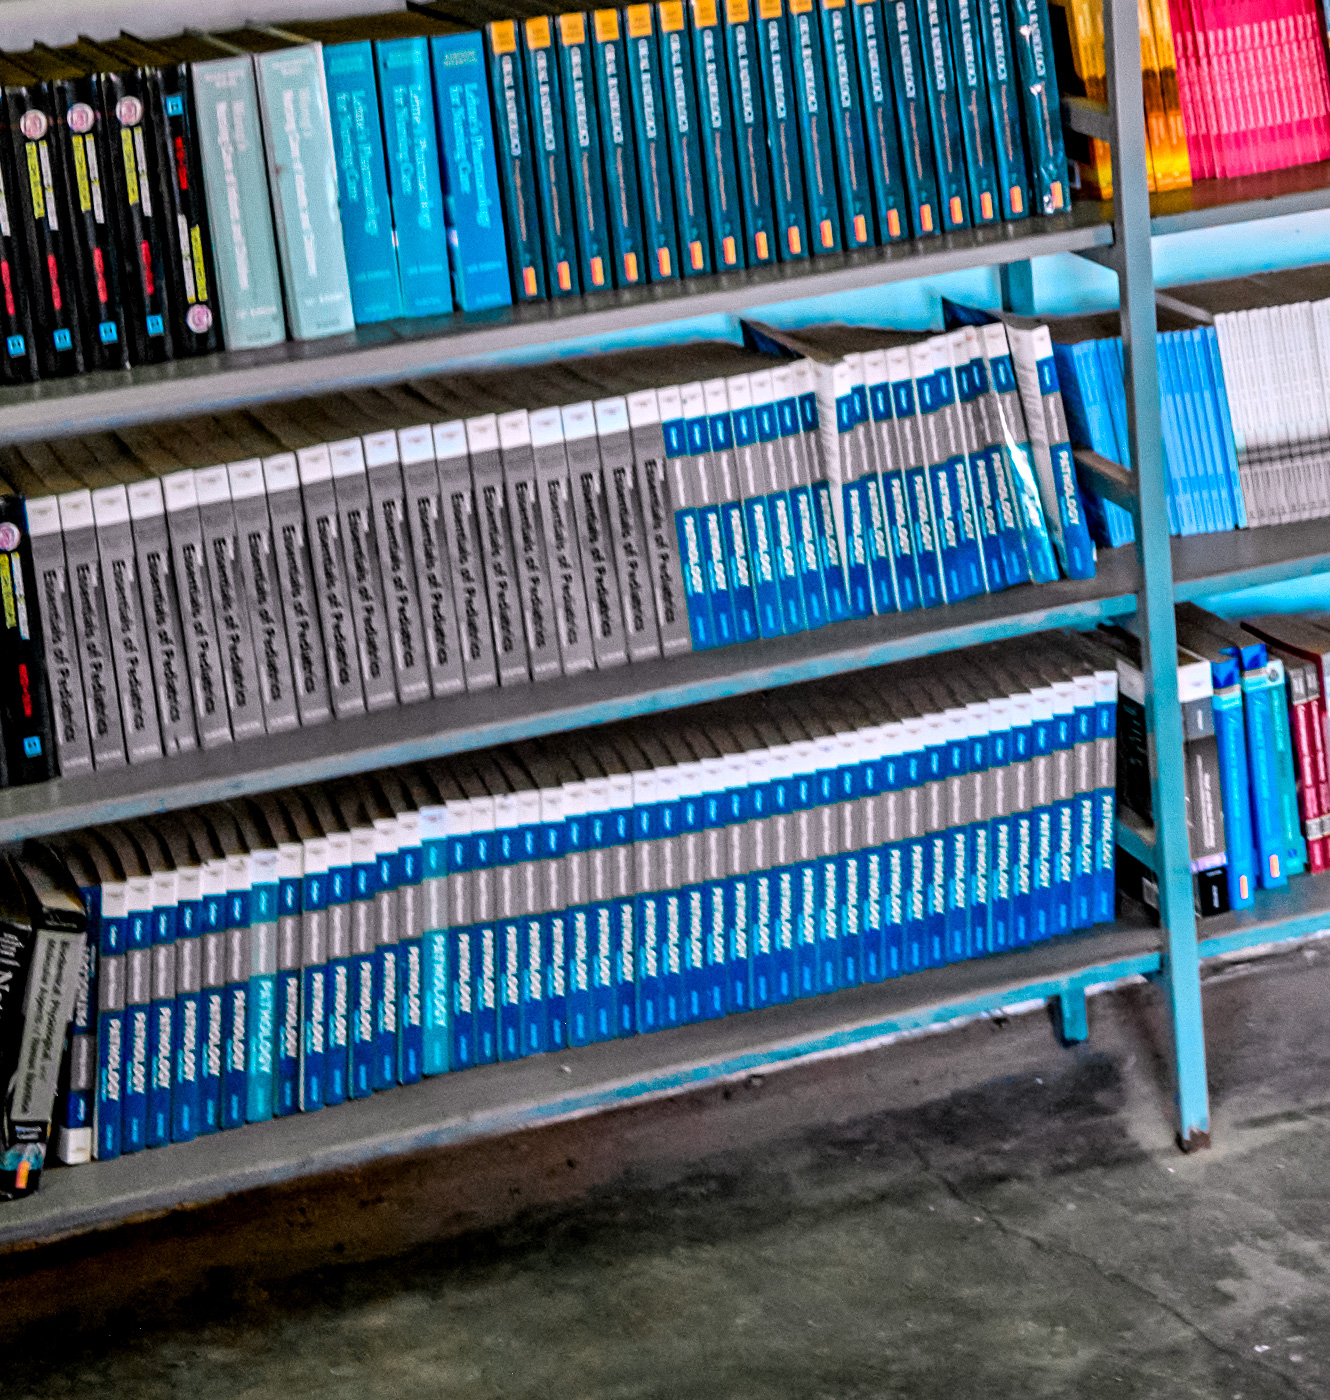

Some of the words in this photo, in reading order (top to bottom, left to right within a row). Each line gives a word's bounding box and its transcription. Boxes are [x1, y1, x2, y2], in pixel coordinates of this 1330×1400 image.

[891, 478, 911, 555] PATHOLOGY
[1058, 450, 1080, 525] PATHOLOGY
[347, 509, 373, 584] Essentials
[418, 498, 441, 570] Essentials
[684, 515, 703, 593] PATHOLOGY
[707, 513, 727, 590] PATHOLOGY
[753, 504, 772, 581] PATHOLOGY
[798, 494, 817, 571] PATHOLOGY
[42, 569, 68, 646] Essentials
[113, 561, 137, 634] Essentials
[146, 551, 172, 627] Essentials
[212, 537, 239, 612] Essentials
[358, 606, 381, 680] Pediatrics
[426, 593, 449, 667] Pediatrics
[53, 669, 77, 743] Pediatrics
[121, 657, 146, 733] Pediatrics
[157, 650, 181, 723] Pediatrics
[223, 634, 247, 708] Pediatrics
[458, 933, 471, 1013] PATHOLOGY
[506, 926, 519, 1005] PATHOLOGY
[552, 918, 565, 996] PATHOLOGY
[598, 908, 611, 986] PATHOLOGY
[645, 900, 657, 977] PATHOLOGY
[285, 977, 298, 1058] PATHOLOGY
[312, 972, 324, 1053] PATHOLOGY
[334, 966, 347, 1046] PATHOLOGY
[360, 961, 372, 1042] PATHOLOGY
[383, 952, 396, 1032] PATHOLOGY
[408, 946, 421, 1026] PATHOLOGY
[433, 935, 446, 1026] PATHOLOGY
[107, 1018, 121, 1100] PATHOLOGY
[132, 1012, 146, 1094] PATHOLOGY
[158, 1007, 172, 1089] PATHOLOGY
[183, 1000, 197, 1082] PATHOLOGY
[208, 994, 221, 1076] PATHOLOGY
[232, 990, 246, 1072] PATHOLOGY
[258, 981, 272, 1073] PATHOLOGY
